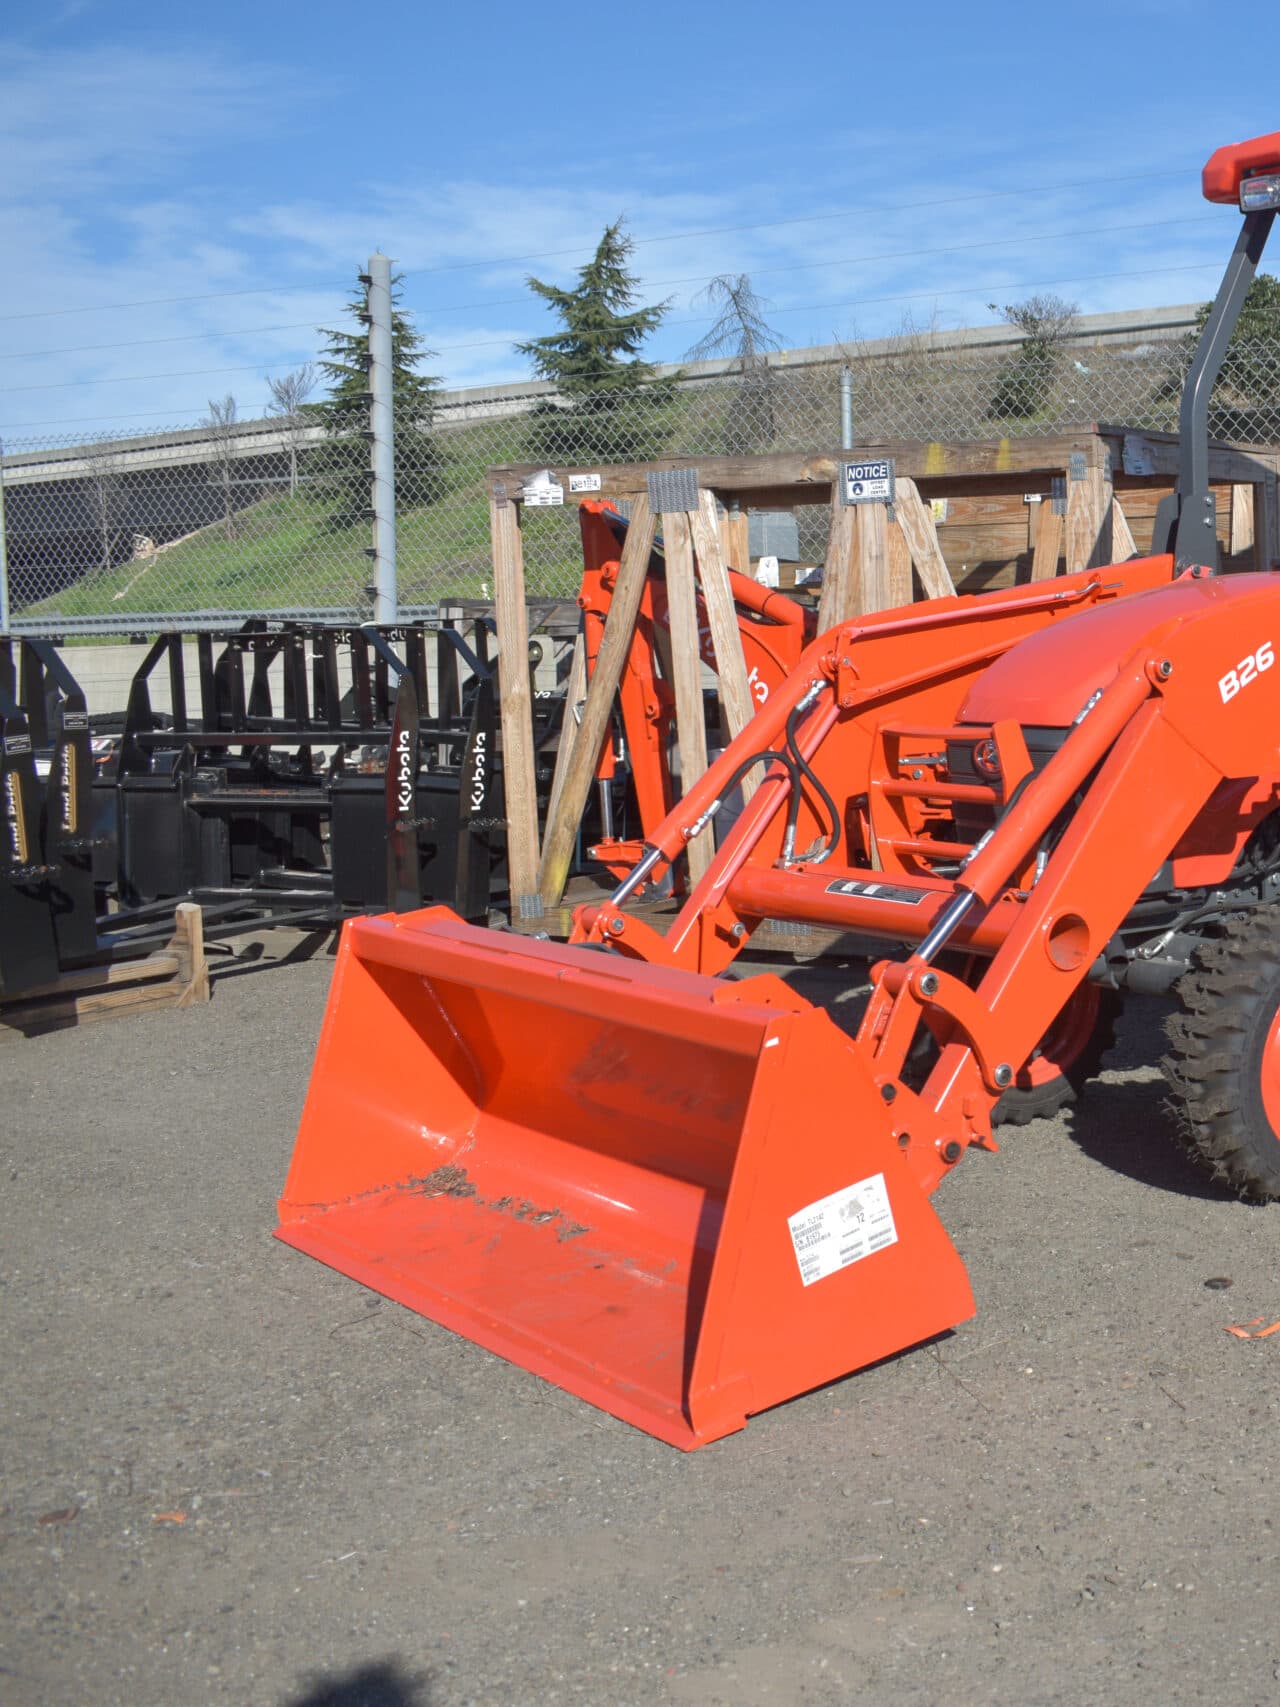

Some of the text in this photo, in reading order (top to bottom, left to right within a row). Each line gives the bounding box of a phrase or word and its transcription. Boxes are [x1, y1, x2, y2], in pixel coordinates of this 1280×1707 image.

[848, 465, 887, 479] NOTICE
[1217, 641, 1275, 704] B26
[61, 744, 70, 831] Land Pride
[396, 730, 412, 812] Kubota
[471, 732, 486, 811] Kubota
[6, 773, 21, 862] Land Pride
[856, 1212, 865, 1224] 12
